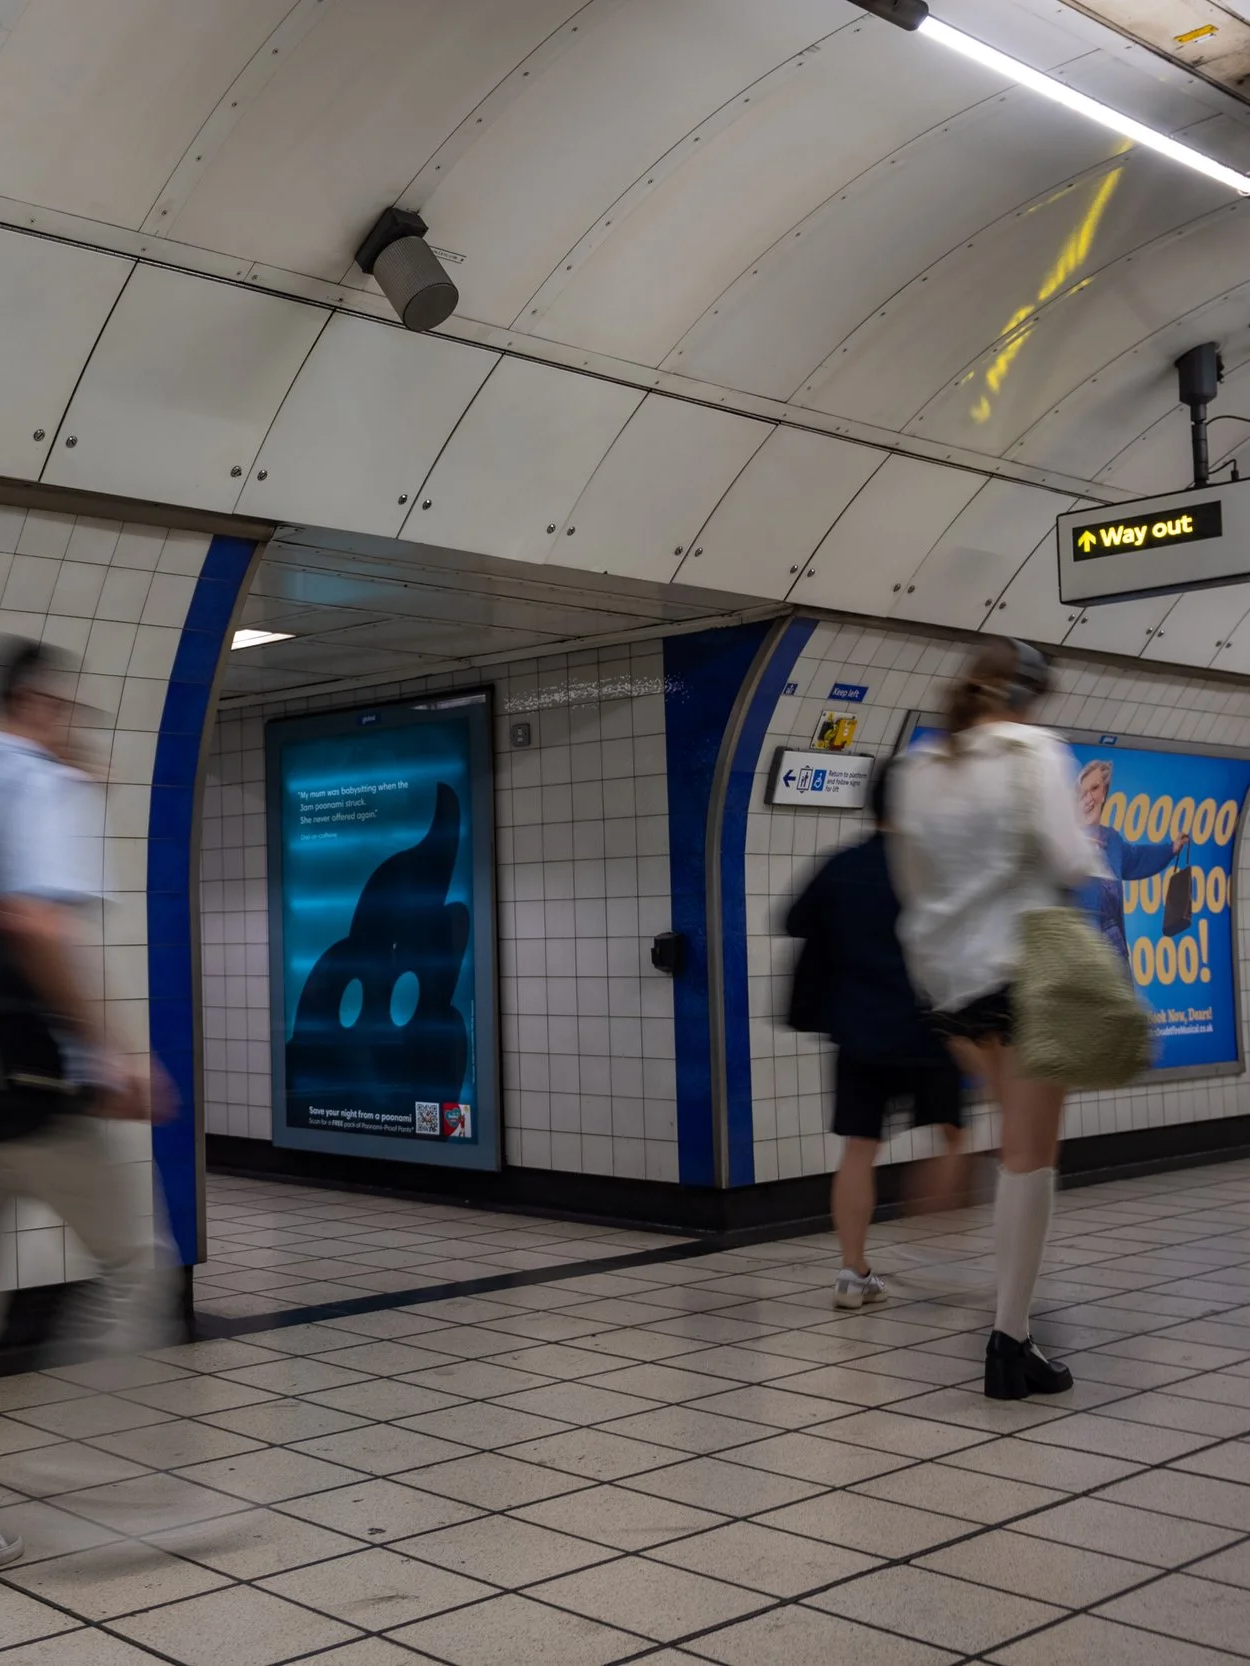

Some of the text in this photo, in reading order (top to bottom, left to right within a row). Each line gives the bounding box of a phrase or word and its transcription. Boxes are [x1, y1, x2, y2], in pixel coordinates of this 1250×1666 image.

[1100, 515, 1193, 547] Way out
[832, 687, 860, 698] Keep left
[310, 790, 326, 798] mum
[327, 788, 340, 796] was
[341, 784, 377, 796] babysitting
[378, 782, 396, 792] when
[397, 780, 409, 790] the
[300, 797, 366, 812] 3am poonami struck.
[300, 816, 312, 825] She
[313, 815, 330, 824] never
[331, 811, 356, 822] offered
[309, 1106, 325, 1115] Save
[325, 1109, 340, 1117] your
[341, 1108, 357, 1120] night
[358, 1110, 374, 1119] from
[381, 1114, 412, 1123] poonami
[332, 1119, 343, 1127] FREE
